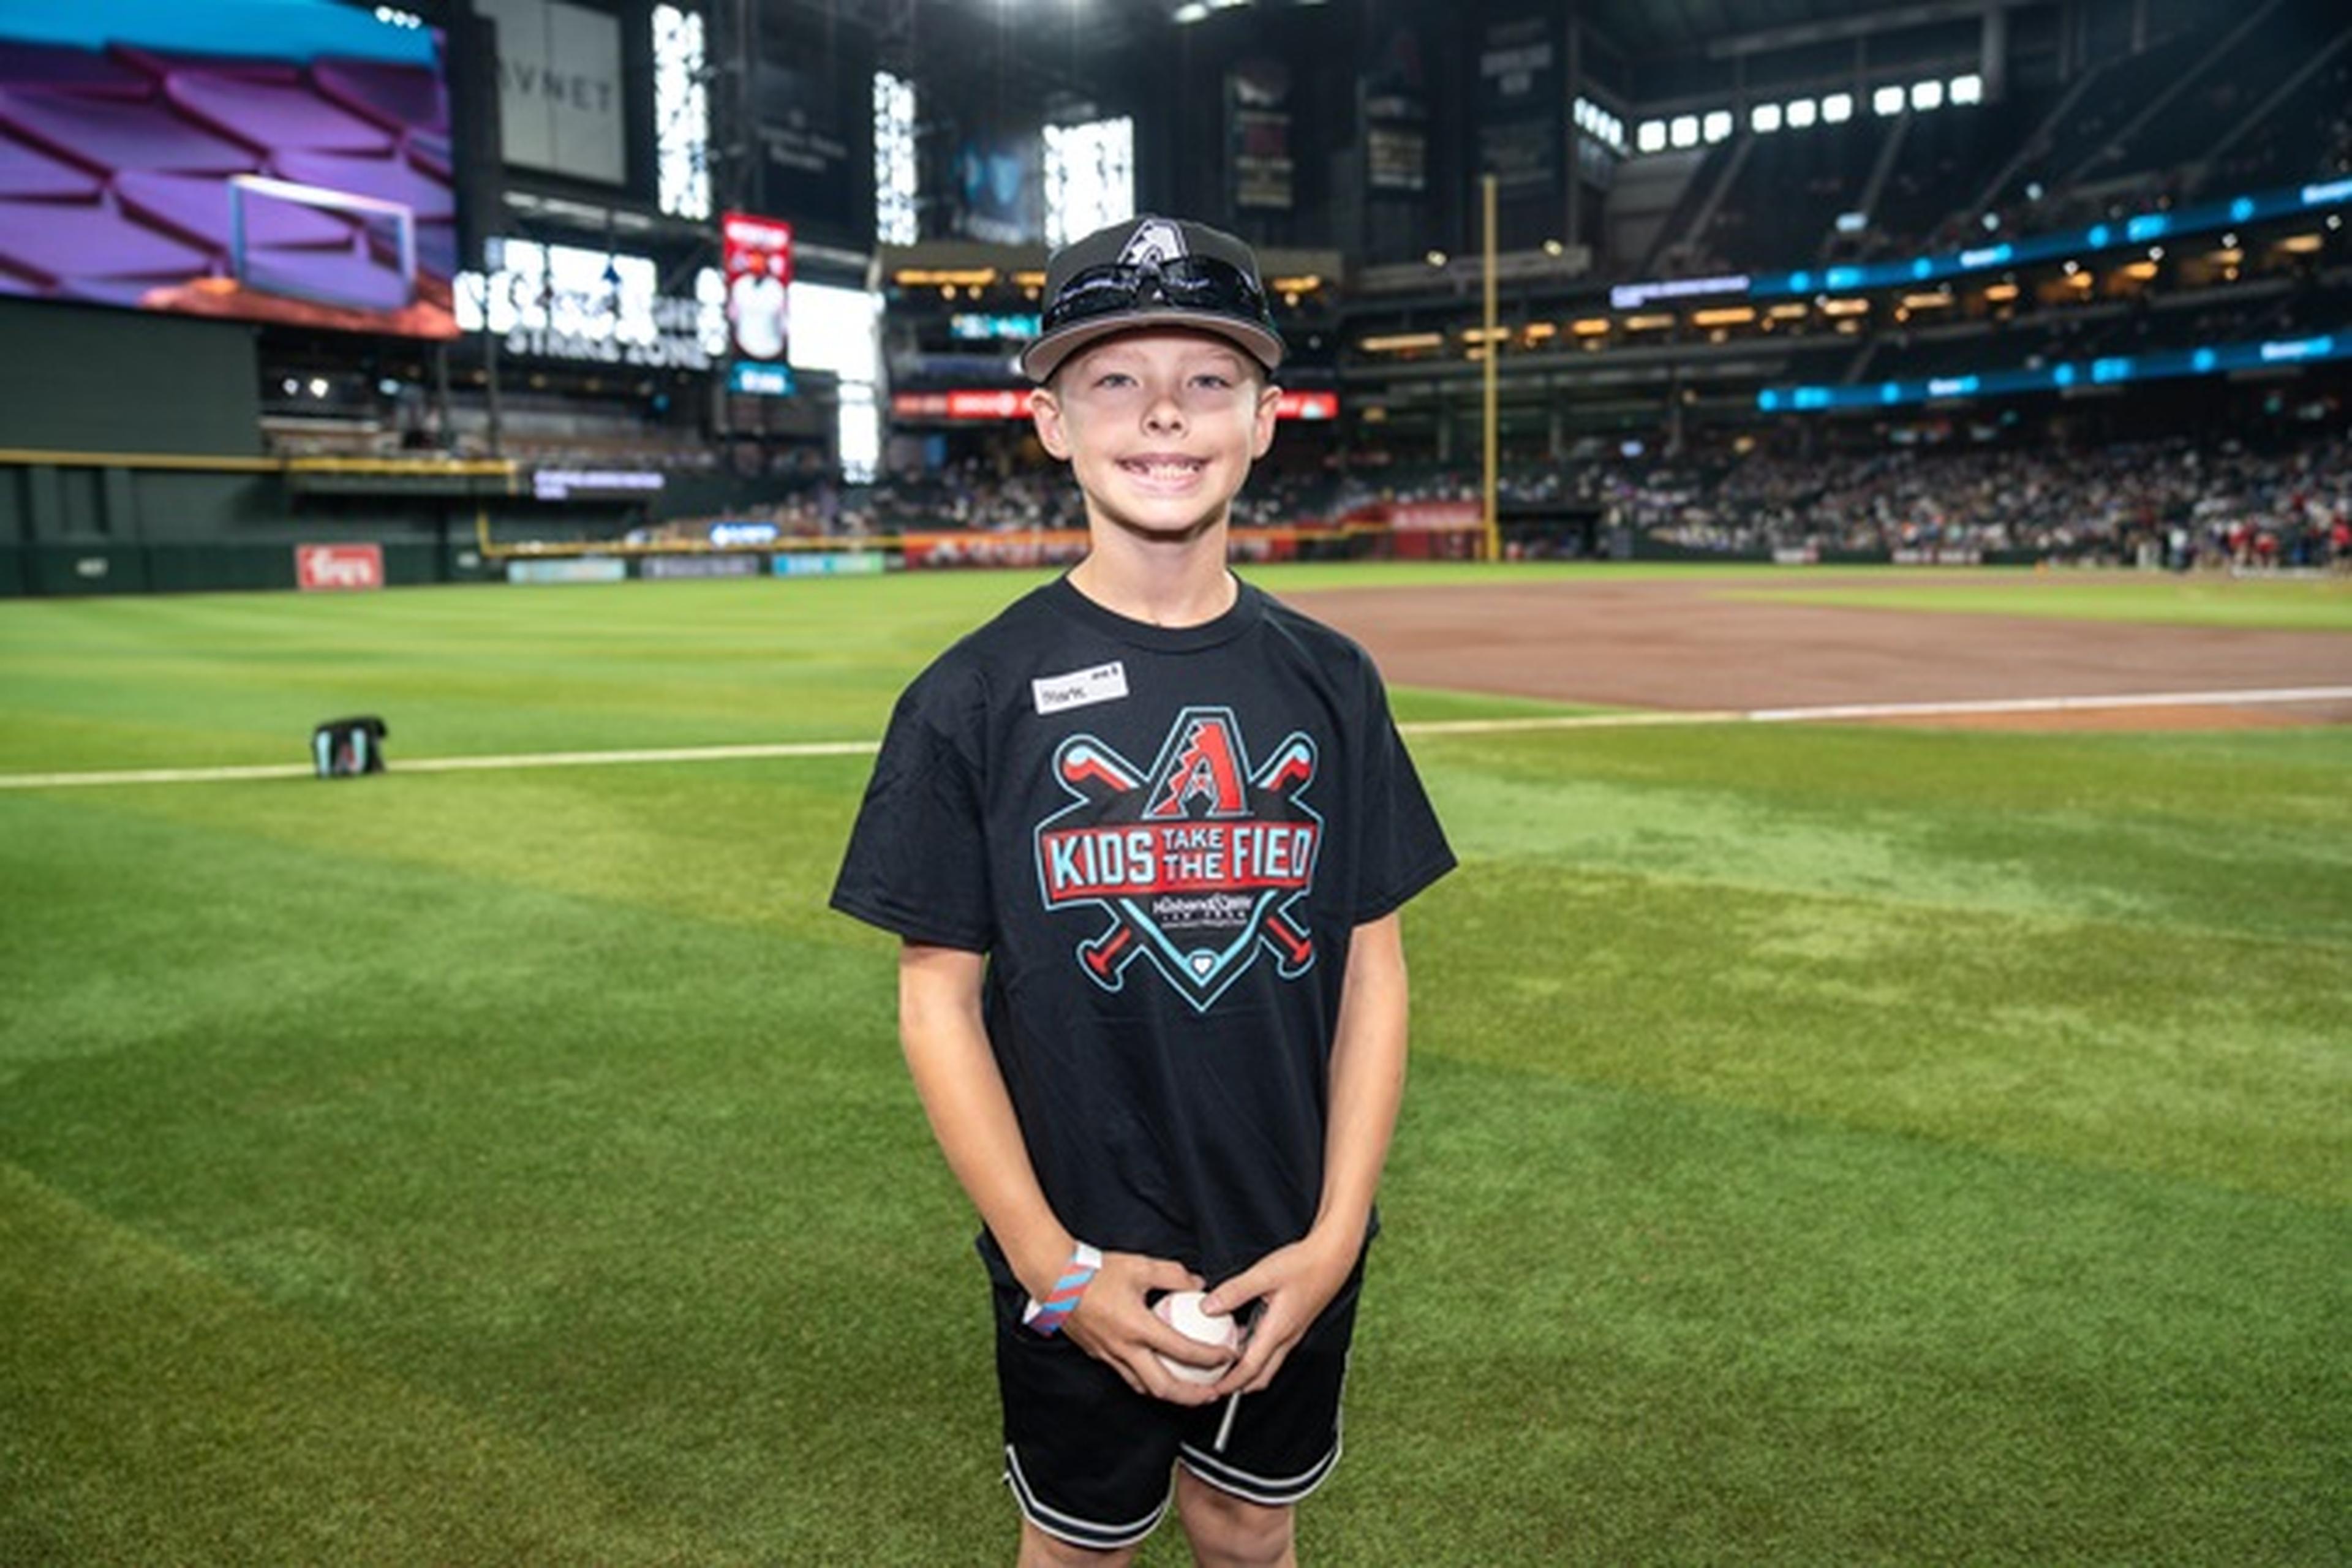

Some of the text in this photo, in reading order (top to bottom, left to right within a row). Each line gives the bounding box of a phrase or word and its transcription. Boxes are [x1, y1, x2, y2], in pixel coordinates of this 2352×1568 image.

[1050, 831, 1155, 889] KIDS
[1163, 828, 1224, 849] TAKE
[1163, 853, 1224, 880] THE
